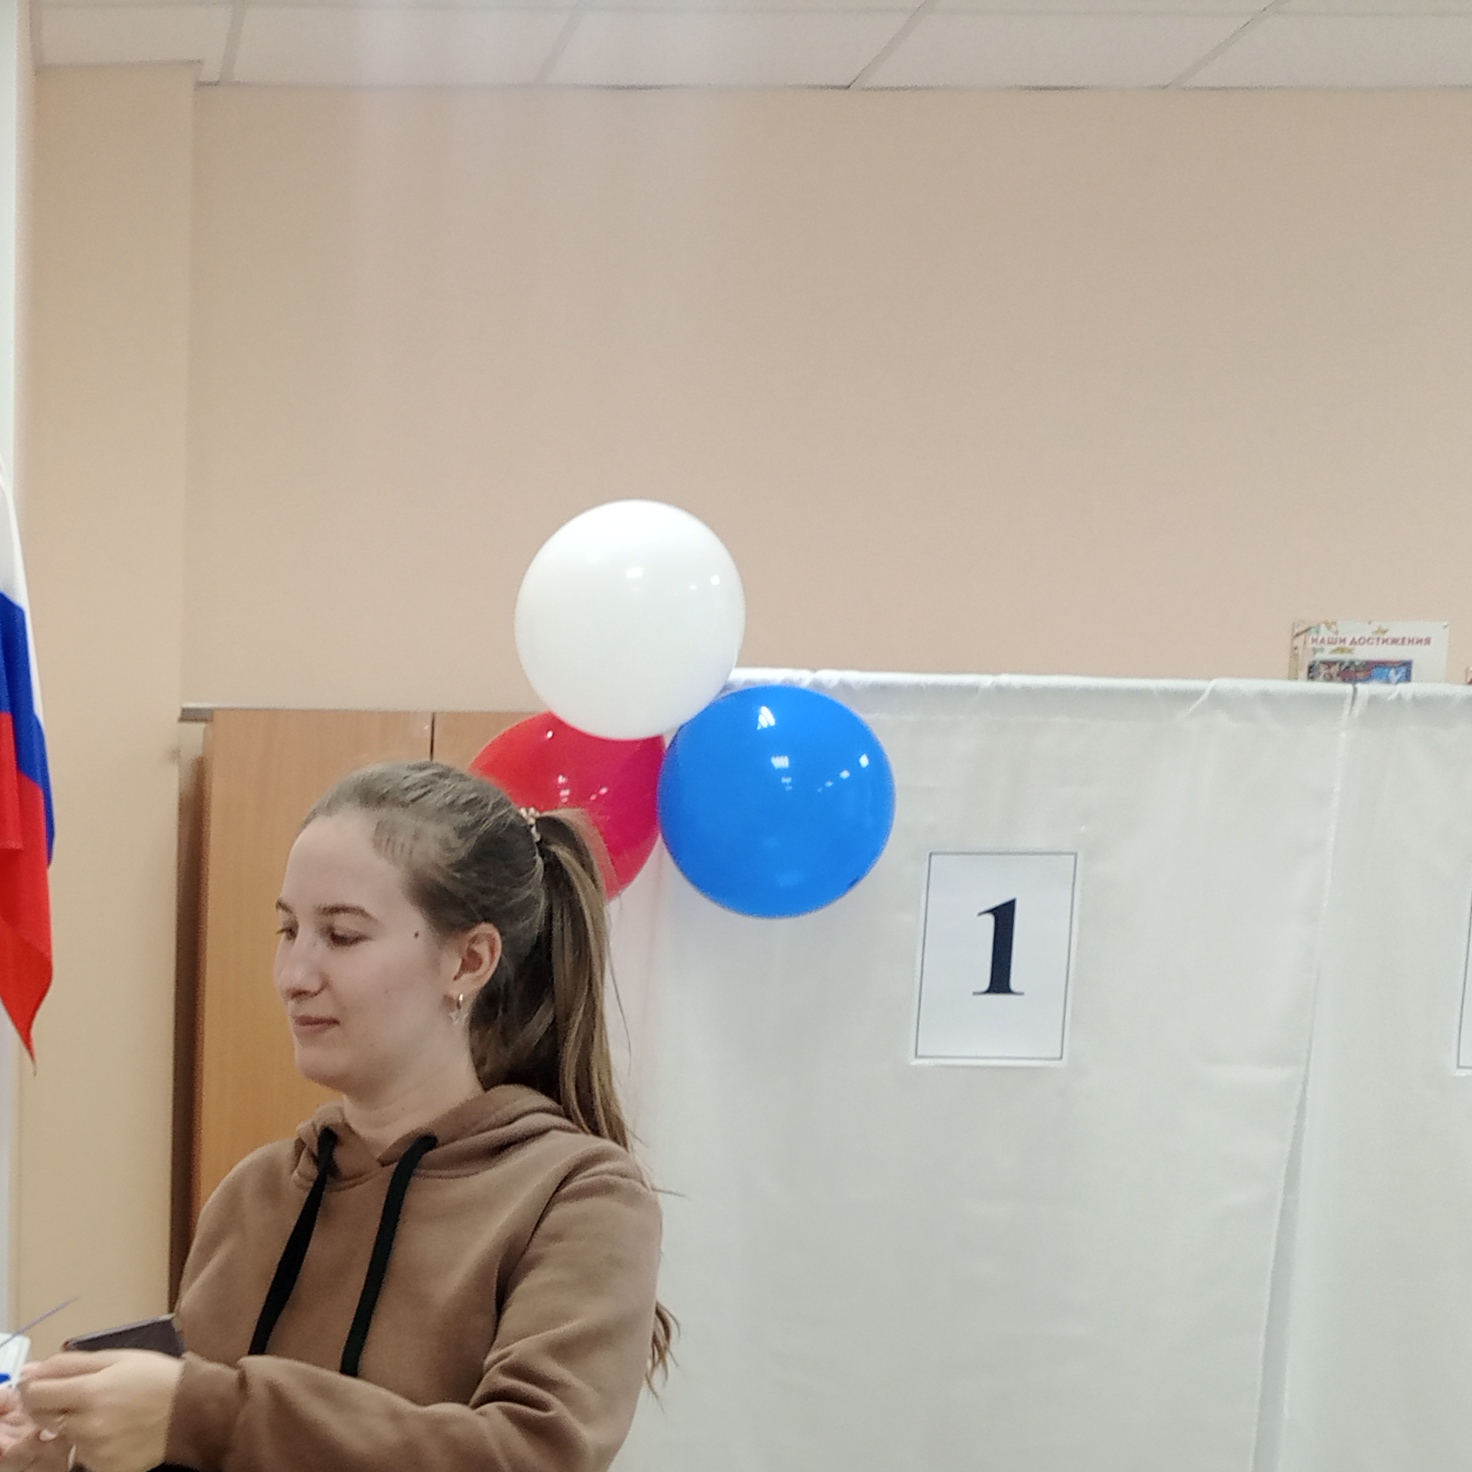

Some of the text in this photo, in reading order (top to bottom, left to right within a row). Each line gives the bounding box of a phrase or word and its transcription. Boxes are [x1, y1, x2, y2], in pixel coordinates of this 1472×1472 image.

[1311, 636, 1431, 646] НАШИ ДОСТИЖЕНИЯ
[972, 897, 1025, 995] 1
